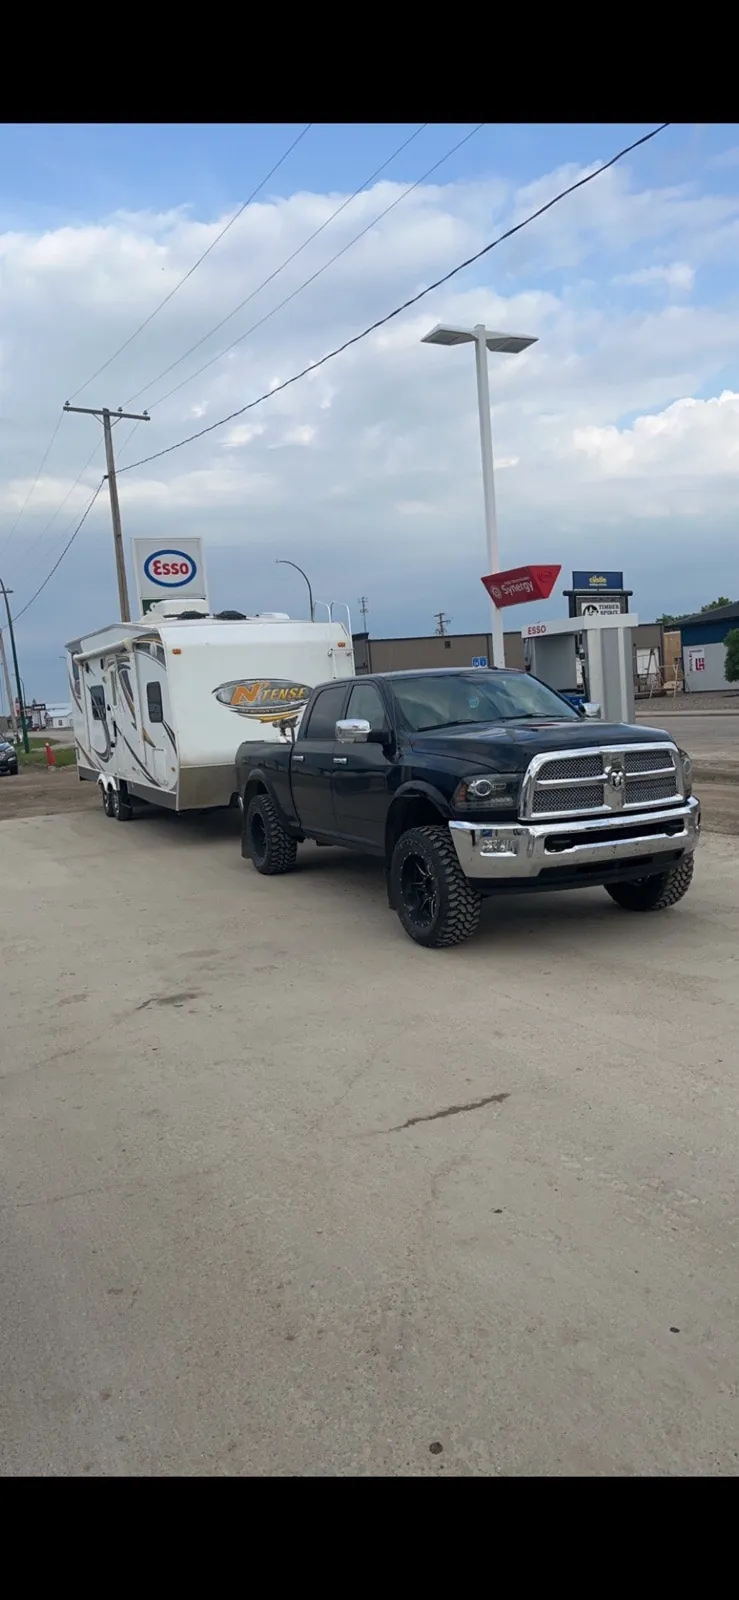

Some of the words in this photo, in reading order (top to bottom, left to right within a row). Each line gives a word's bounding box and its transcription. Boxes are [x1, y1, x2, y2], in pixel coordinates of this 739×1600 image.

[152, 559, 190, 576] Esso
[500, 580, 534, 596] Synergy
[527, 624, 547, 635] ESSO
